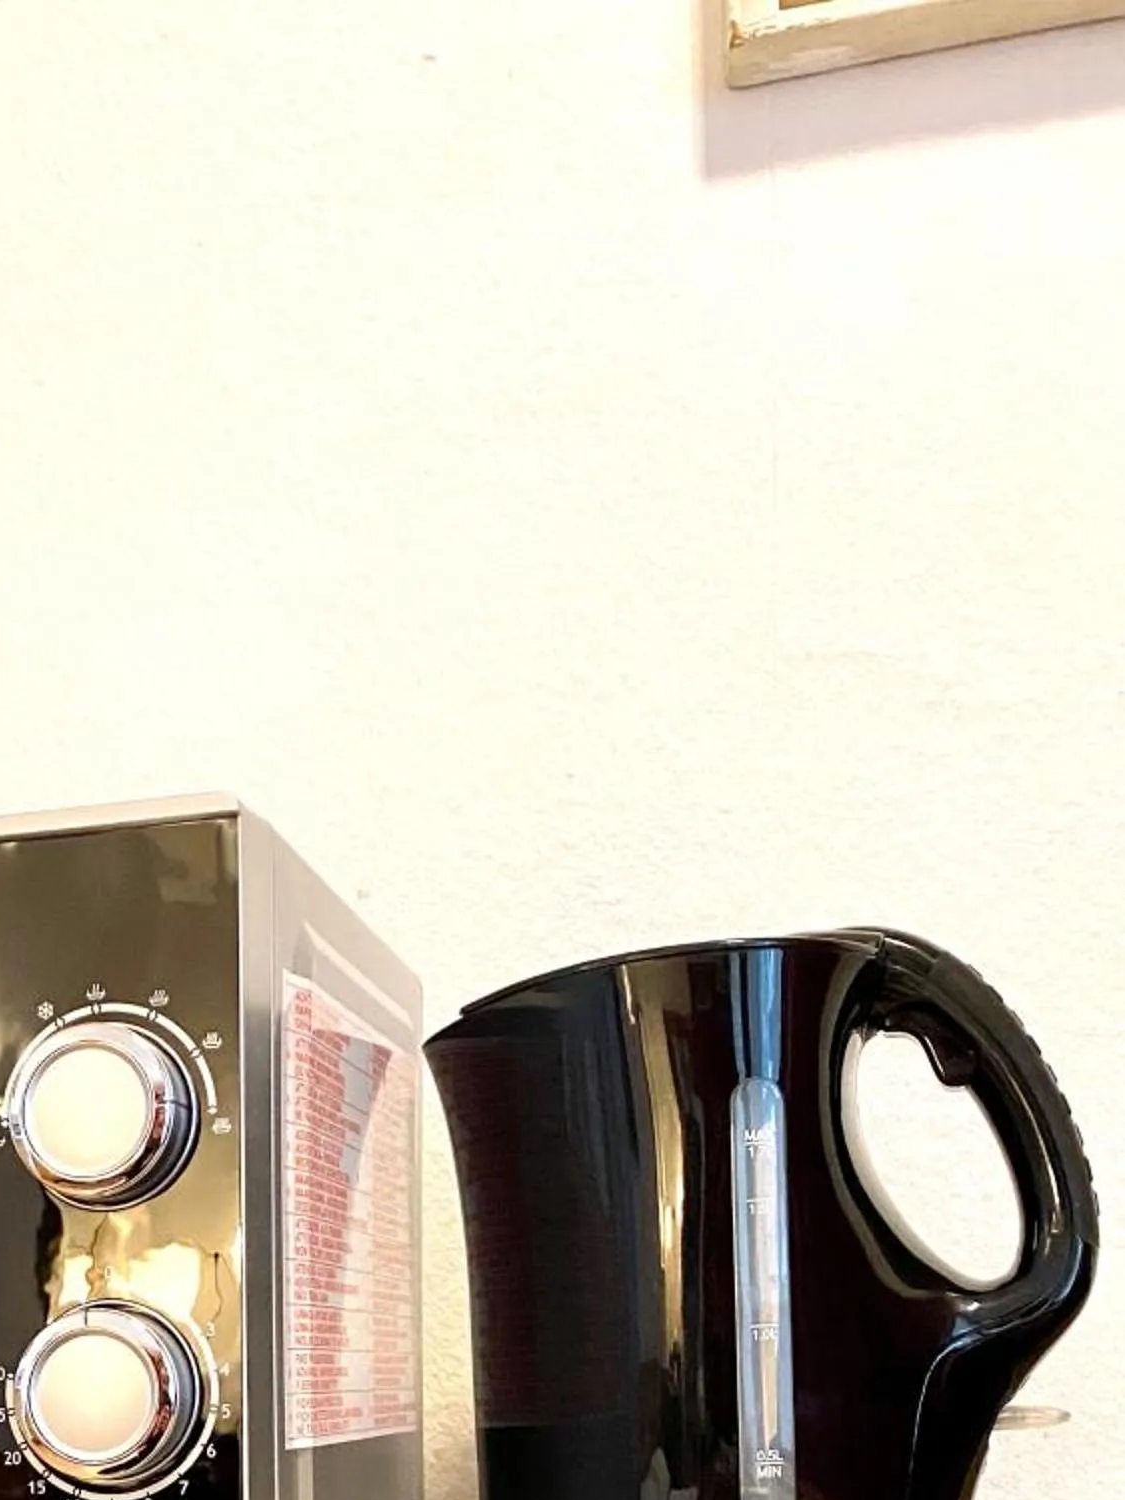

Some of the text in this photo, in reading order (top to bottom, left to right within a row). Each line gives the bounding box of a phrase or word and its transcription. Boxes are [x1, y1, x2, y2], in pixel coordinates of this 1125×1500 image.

[205, 1321, 215, 1337] 3
[218, 1361, 231, 1377] 4
[221, 1403, 232, 1419] 5
[4, 1451, 22, 1466] 20
[206, 1443, 217, 1459] 6
[757, 1465, 783, 1479] MIN
[28, 1481, 47, 1495] 15
[179, 1480, 190, 1496] 7
